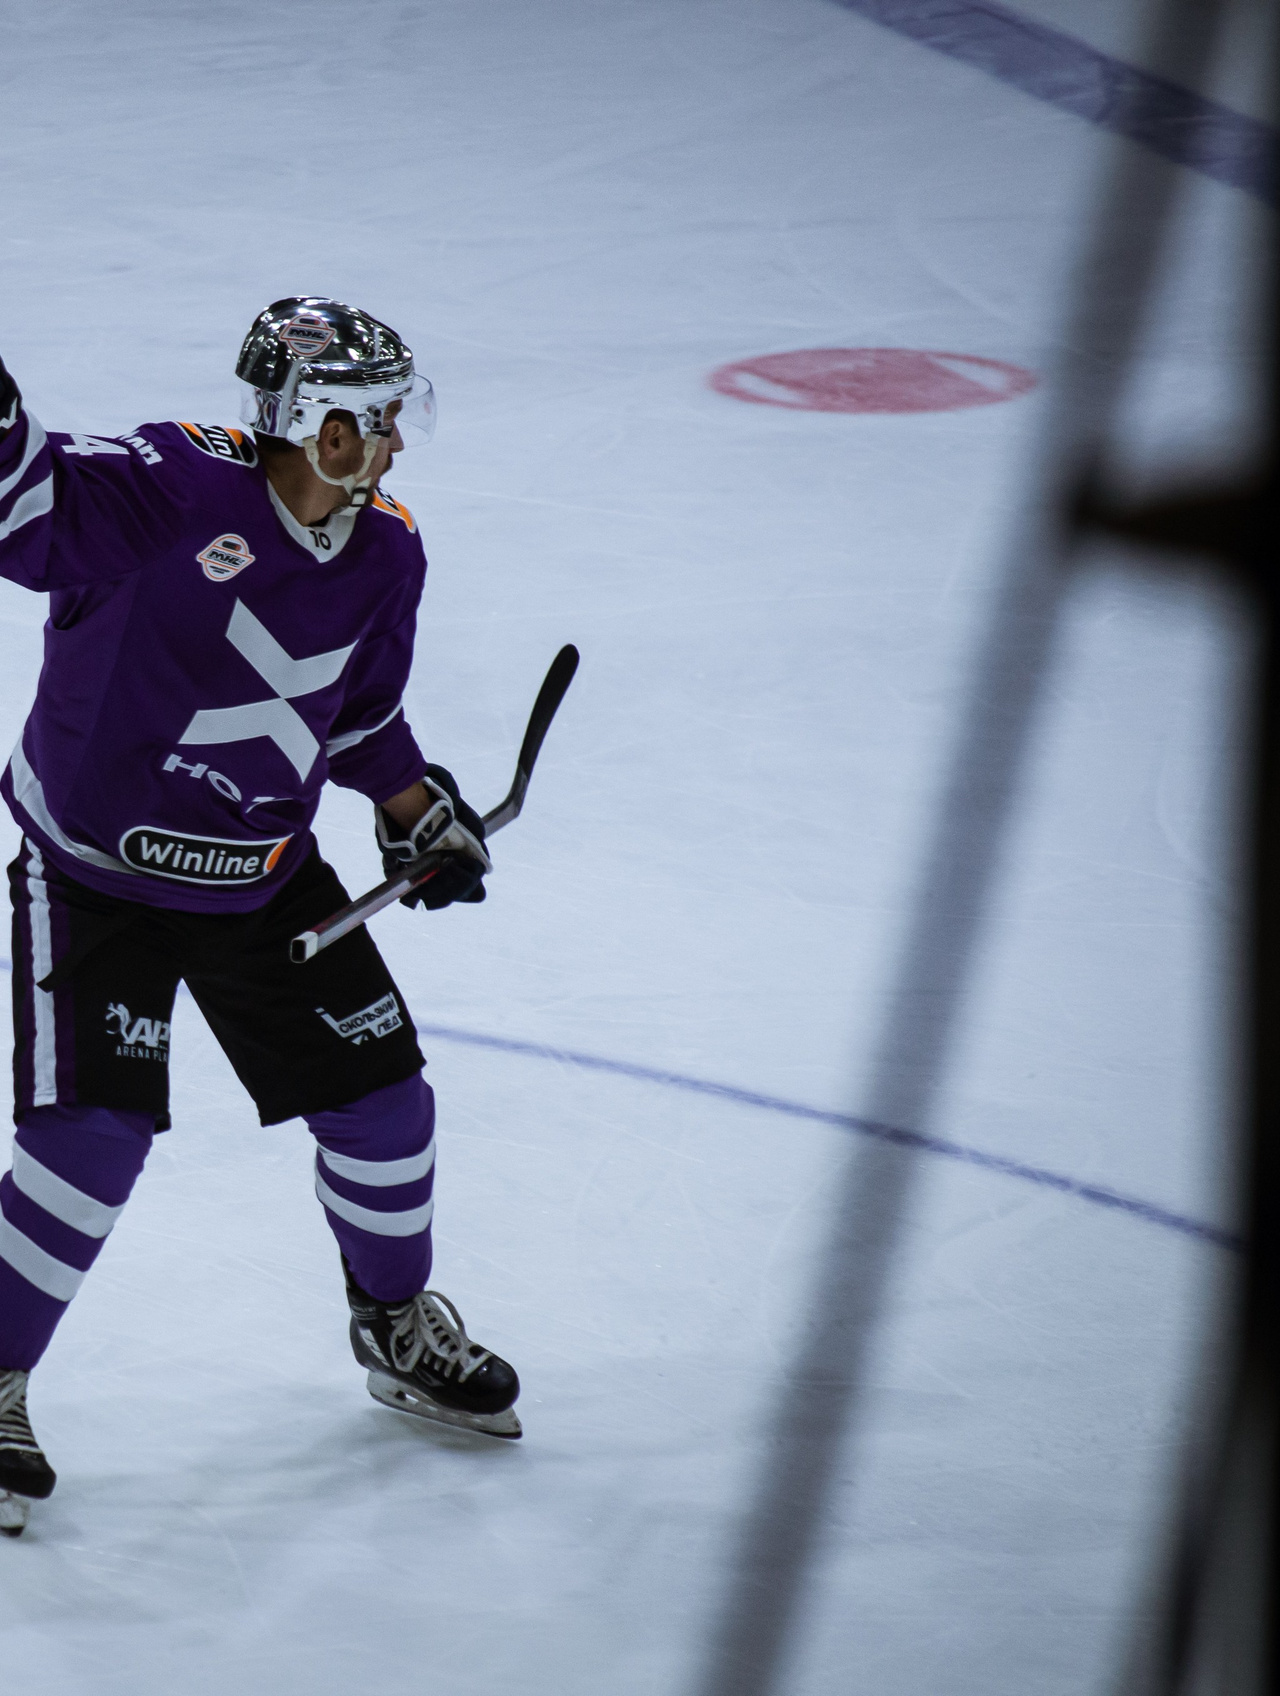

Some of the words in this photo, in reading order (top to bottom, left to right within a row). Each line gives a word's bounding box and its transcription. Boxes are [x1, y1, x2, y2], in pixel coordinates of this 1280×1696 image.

[309, 529, 332, 551] 10
[140, 836, 261, 875] Winline
[116, 1045, 150, 1059] ARENA
